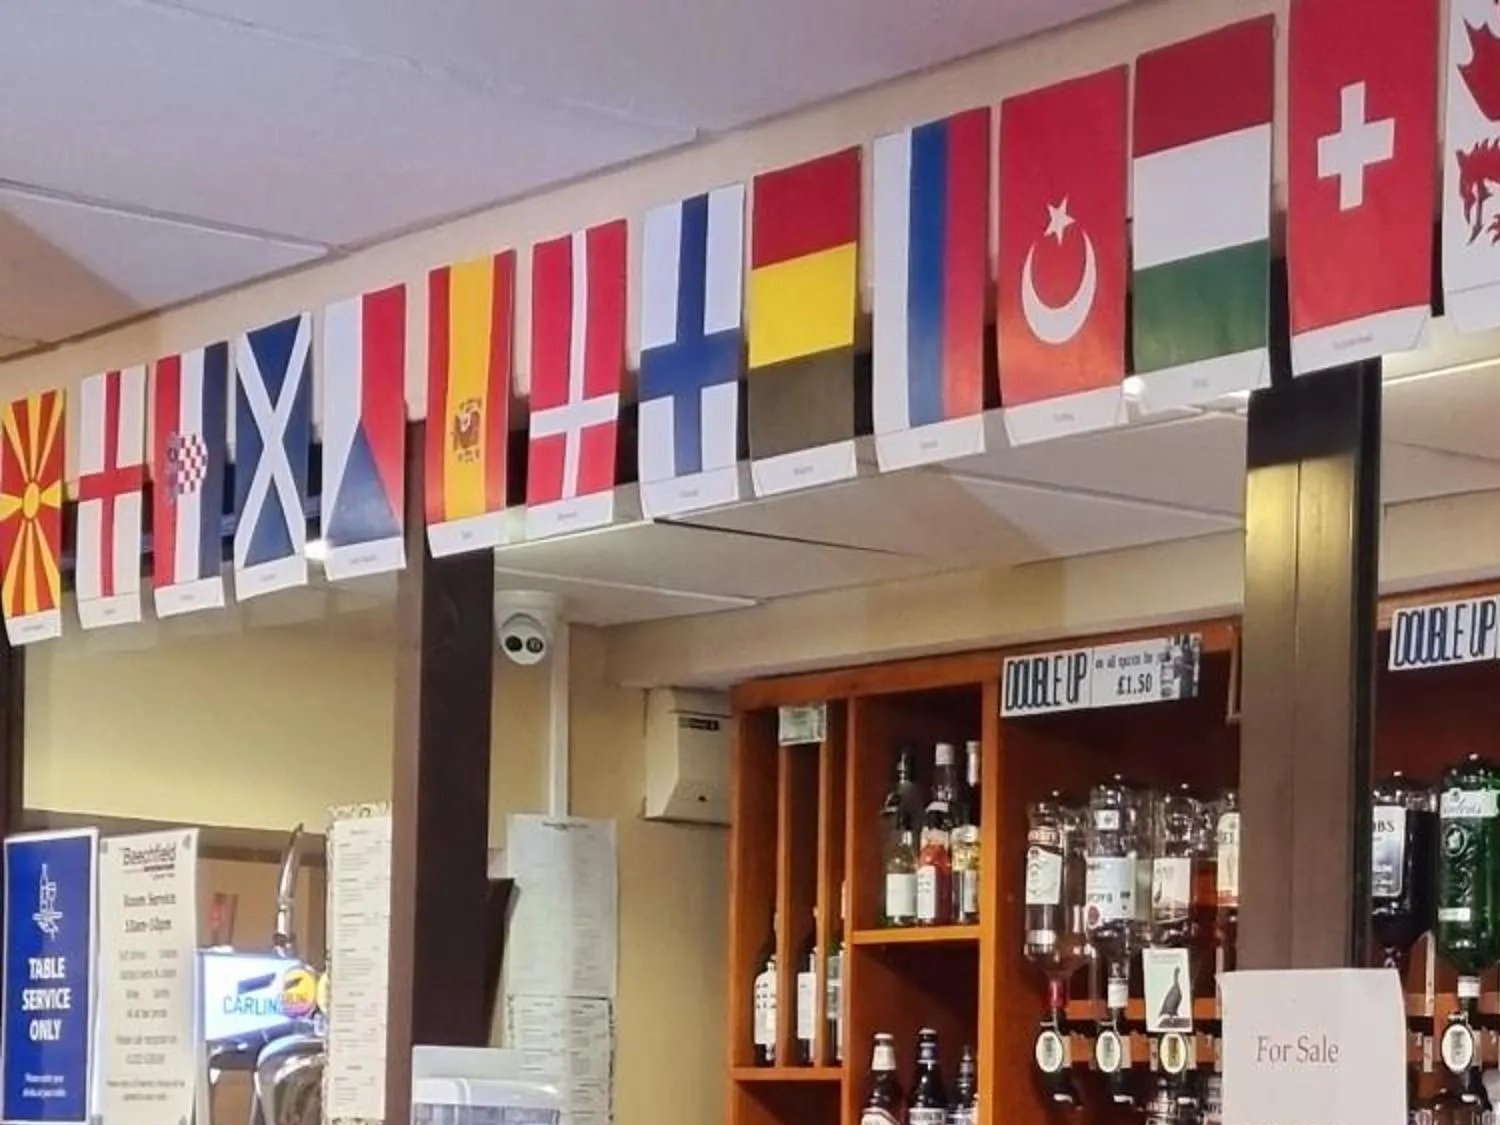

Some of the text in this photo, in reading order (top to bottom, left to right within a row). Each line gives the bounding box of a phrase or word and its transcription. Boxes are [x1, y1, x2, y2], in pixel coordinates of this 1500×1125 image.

[1393, 599, 1497, 667] DOUBLE UP
[1004, 651, 1088, 711] DOUBLE UP
[1116, 673, 1154, 697] £1.50
[28, 957, 67, 981] TABLE
[21, 987, 72, 1012] SERVICE
[28, 1018, 64, 1042] ONLY
[1256, 1034, 1340, 1064] For Sale
